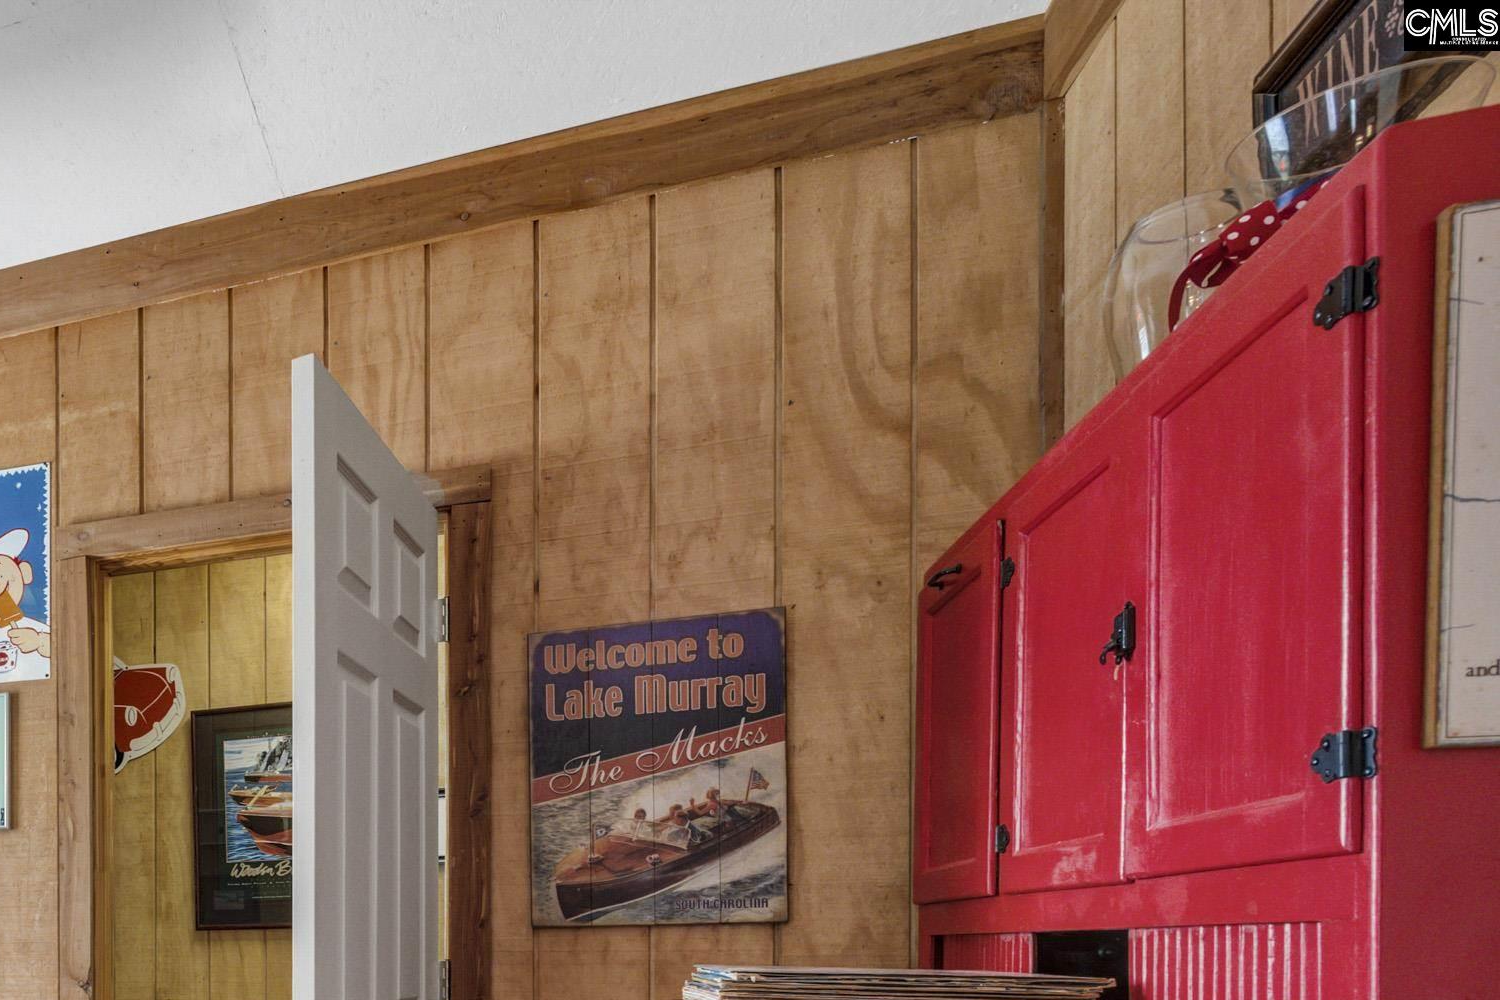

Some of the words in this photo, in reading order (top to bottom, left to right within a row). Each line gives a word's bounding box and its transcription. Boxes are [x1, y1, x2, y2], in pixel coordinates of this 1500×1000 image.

[543, 636, 698, 675] Welcome
[706, 628, 744, 660] to
[1465, 658, 1500, 677] and
[545, 680, 623, 722] Lake
[634, 672, 767, 715] Murray
[549, 750, 624, 795] The
[636, 717, 768, 773] Macks
[675, 899, 712, 910] SOUTH
[713, 897, 769, 910] CAROLINA
